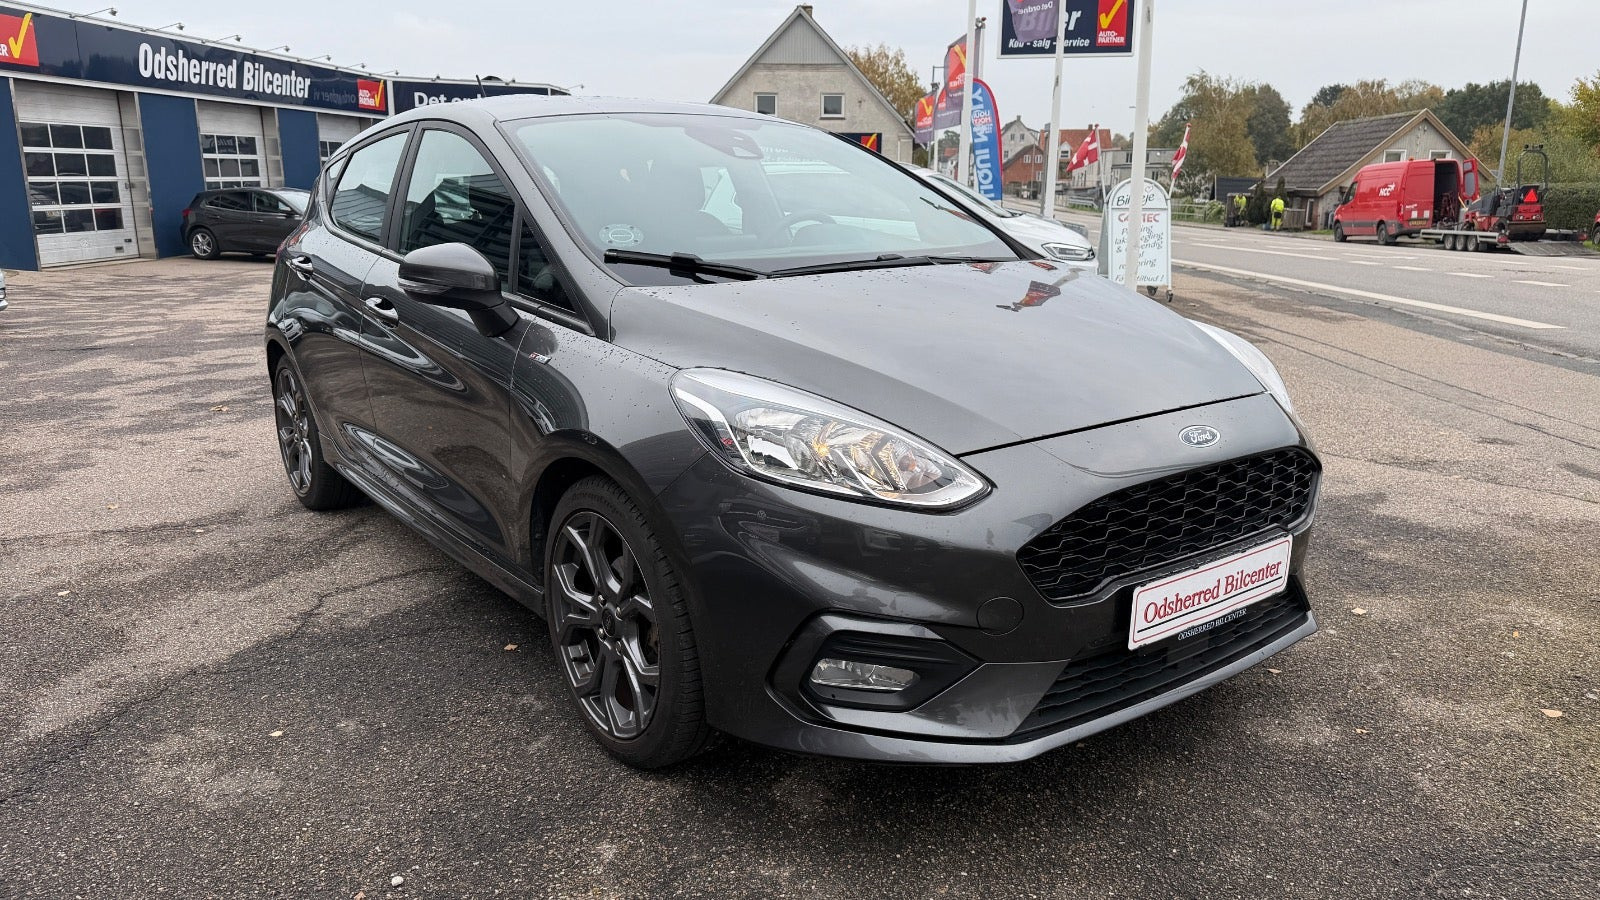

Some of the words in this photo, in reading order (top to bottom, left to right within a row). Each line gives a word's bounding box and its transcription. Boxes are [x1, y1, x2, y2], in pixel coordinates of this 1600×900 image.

[1032, 38, 1051, 49] salg
[1063, 37, 1091, 47] ervice
[138, 42, 237, 90] Odsherred
[242, 60, 311, 99] Bilcenter
[413, 91, 447, 108] Det
[1379, 187, 1391, 197] NCC
[1118, 213, 1160, 223] CATEC
[1143, 579, 1221, 624] Odsherred
[1224, 561, 1282, 595] Bilcenter
[1177, 621, 1215, 641] ODSHERRED
[1215, 608, 1247, 628] BILCENTER
